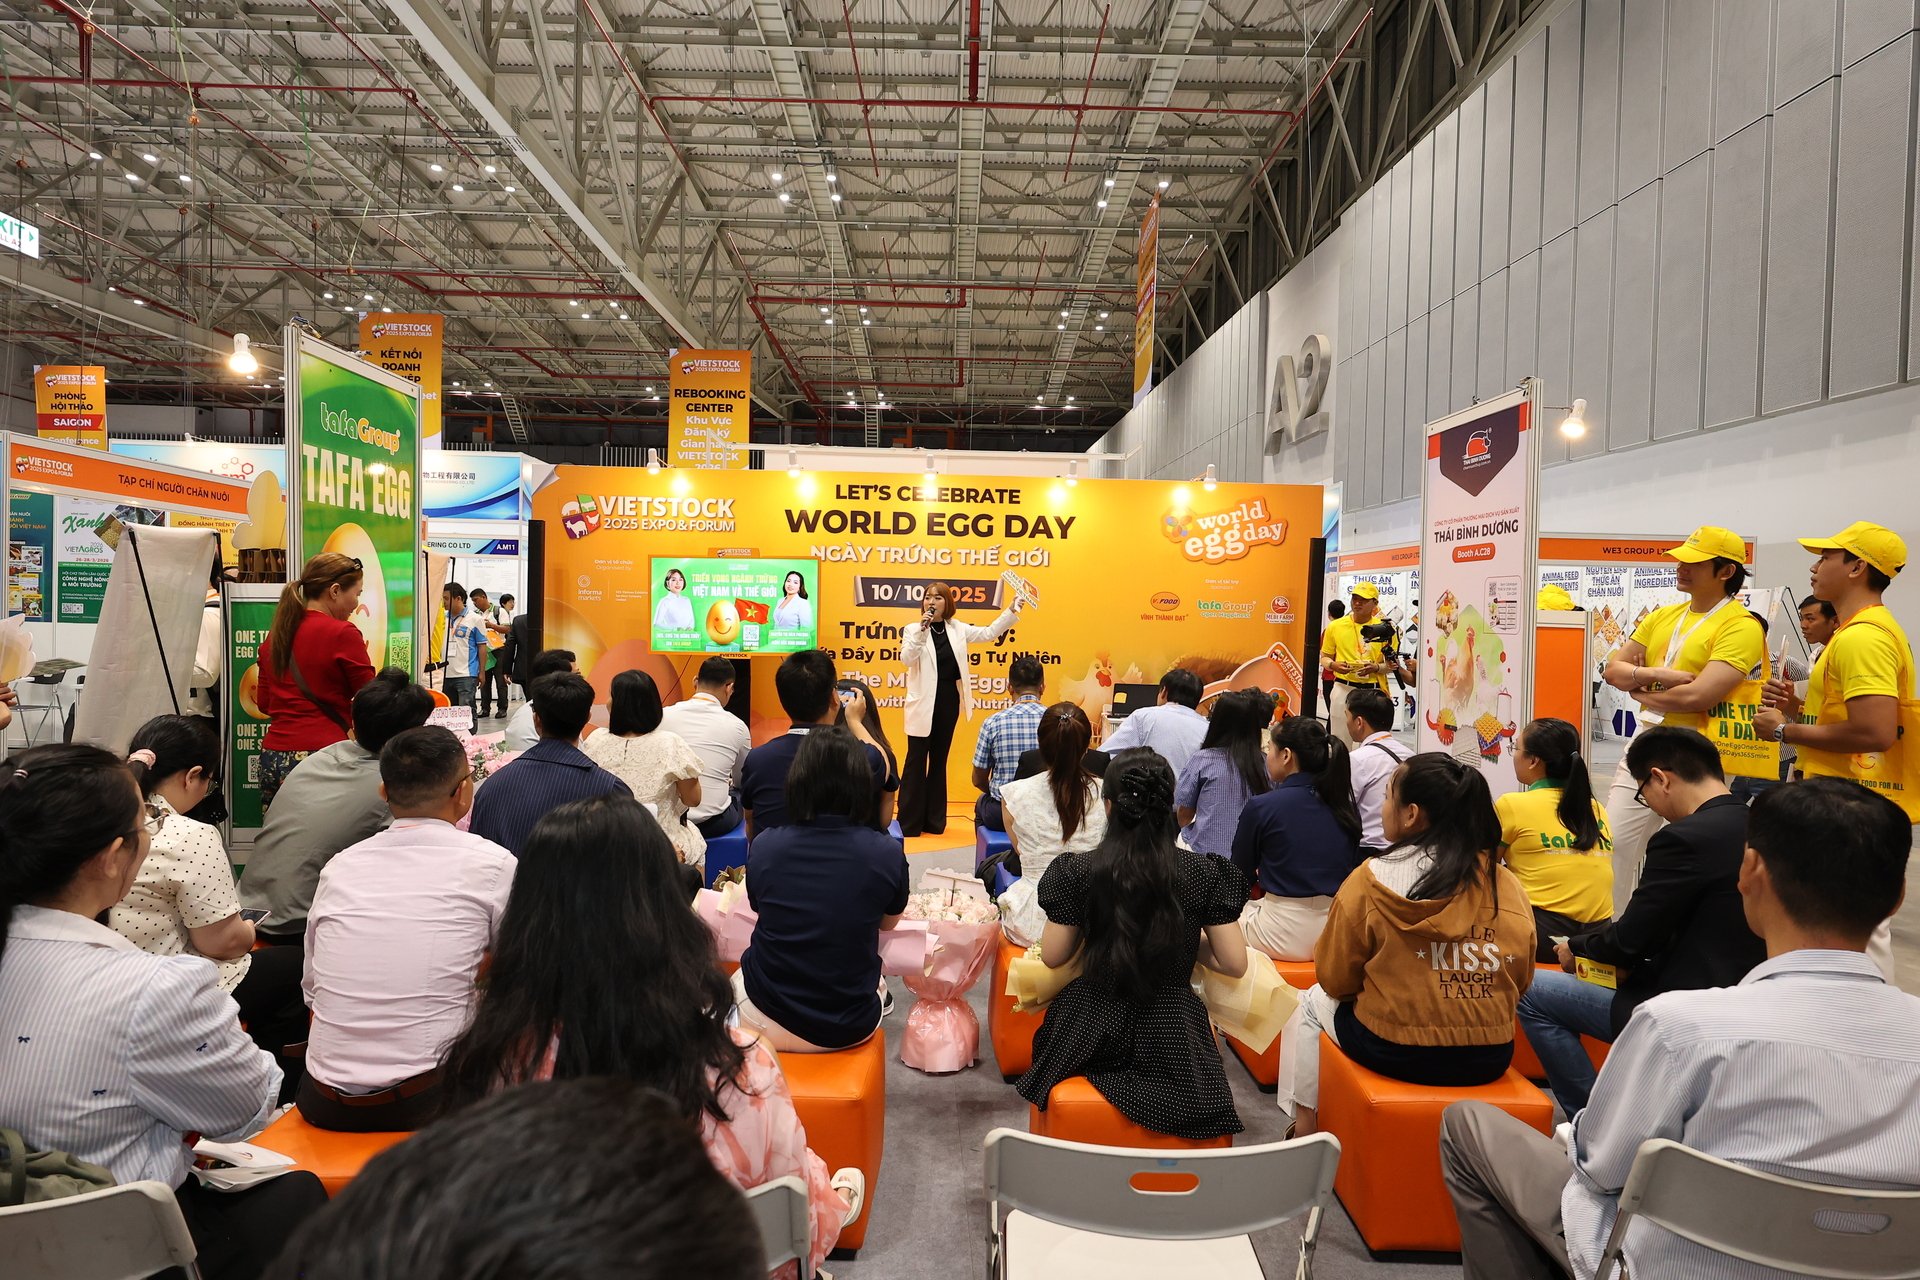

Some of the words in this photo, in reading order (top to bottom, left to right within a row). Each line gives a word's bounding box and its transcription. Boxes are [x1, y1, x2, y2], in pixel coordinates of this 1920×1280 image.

[384, 323, 432, 332] VIETSTOCK
[381, 347, 401, 359] KẾT
[403, 347, 422, 359] NỐI
[382, 363, 421, 372] DOANH
[694, 360, 740, 368] VIETSTOCK
[56, 374, 96, 382] VIETSTOCK
[54, 391, 86, 401] PHÒNG
[674, 389, 746, 399] REBOOKING
[1264, 334, 1330, 456] A2
[50, 402, 66, 412] HỘI
[68, 402, 93, 410] THẢO
[686, 403, 733, 413] CENTER
[53, 418, 92, 427] SAIGON
[686, 416, 708, 425] Khu
[711, 416, 732, 427] Vực
[717, 428, 730, 439] ký
[680, 439, 705, 448] Gian
[28, 456, 73, 472] VIETSTOCK
[303, 443, 365, 511] TAFA
[371, 462, 410, 520] EGG
[118, 474, 137, 488] TẠP
[139, 477, 155, 489] CHÍ
[157, 480, 184, 495] NGƯỜI
[186, 486, 209, 498] CHĂN
[210, 490, 230, 502] NUÔI
[836, 484, 891, 501] LET'S
[897, 486, 1021, 505] CELEBRATE
[599, 496, 736, 518] VIETSTOCK
[1196, 500, 1264, 530] world
[62, 512, 105, 534] Xanh
[604, 518, 638, 530] 2025
[785, 509, 917, 535] WORLD
[927, 512, 994, 538] EGG
[1004, 514, 1076, 539] DAY
[1434, 526, 1454, 543] THÁI
[1456, 524, 1479, 540] BÌNH
[1482, 519, 1519, 537] DƯƠNG
[1184, 522, 1245, 560] egg
[1243, 523, 1283, 541] day
[810, 541, 872, 562] NGÀY
[876, 543, 952, 565] TRỨNG
[957, 544, 1002, 566] THẾ
[1004, 546, 1050, 567] GIỚI
[1457, 550, 1474, 558] Booth
[1475, 548, 1491, 557] A.C28
[1603, 547, 1622, 555] WE3
[1542, 572, 1564, 581] ANIMAL
[1565, 570, 1579, 580] FEED
[1634, 567, 1662, 577] ANIMAL
[1353, 574, 1377, 584] THỨC
[692, 584, 709, 598] VIỆT
[711, 586, 729, 596] NAM
[732, 585, 743, 597] VÀ
[1607, 586, 1624, 597] NUÔI
[235, 630, 256, 644] ONE
[235, 646, 254, 658] EGG
[841, 646, 875, 663] Đầy
[986, 651, 1008, 667] Tự
[1708, 702, 1735, 719] ONE
[237, 723, 257, 737] ONE
[1719, 721, 1729, 738] A
[237, 738, 255, 750] ONE
[1862, 780, 1877, 788] FOOD
[1879, 781, 1891, 789] FOR
[1431, 942, 1500, 972] KISS
[1440, 973, 1493, 983] LAUGH
[1440, 984, 1493, 999] TALK
